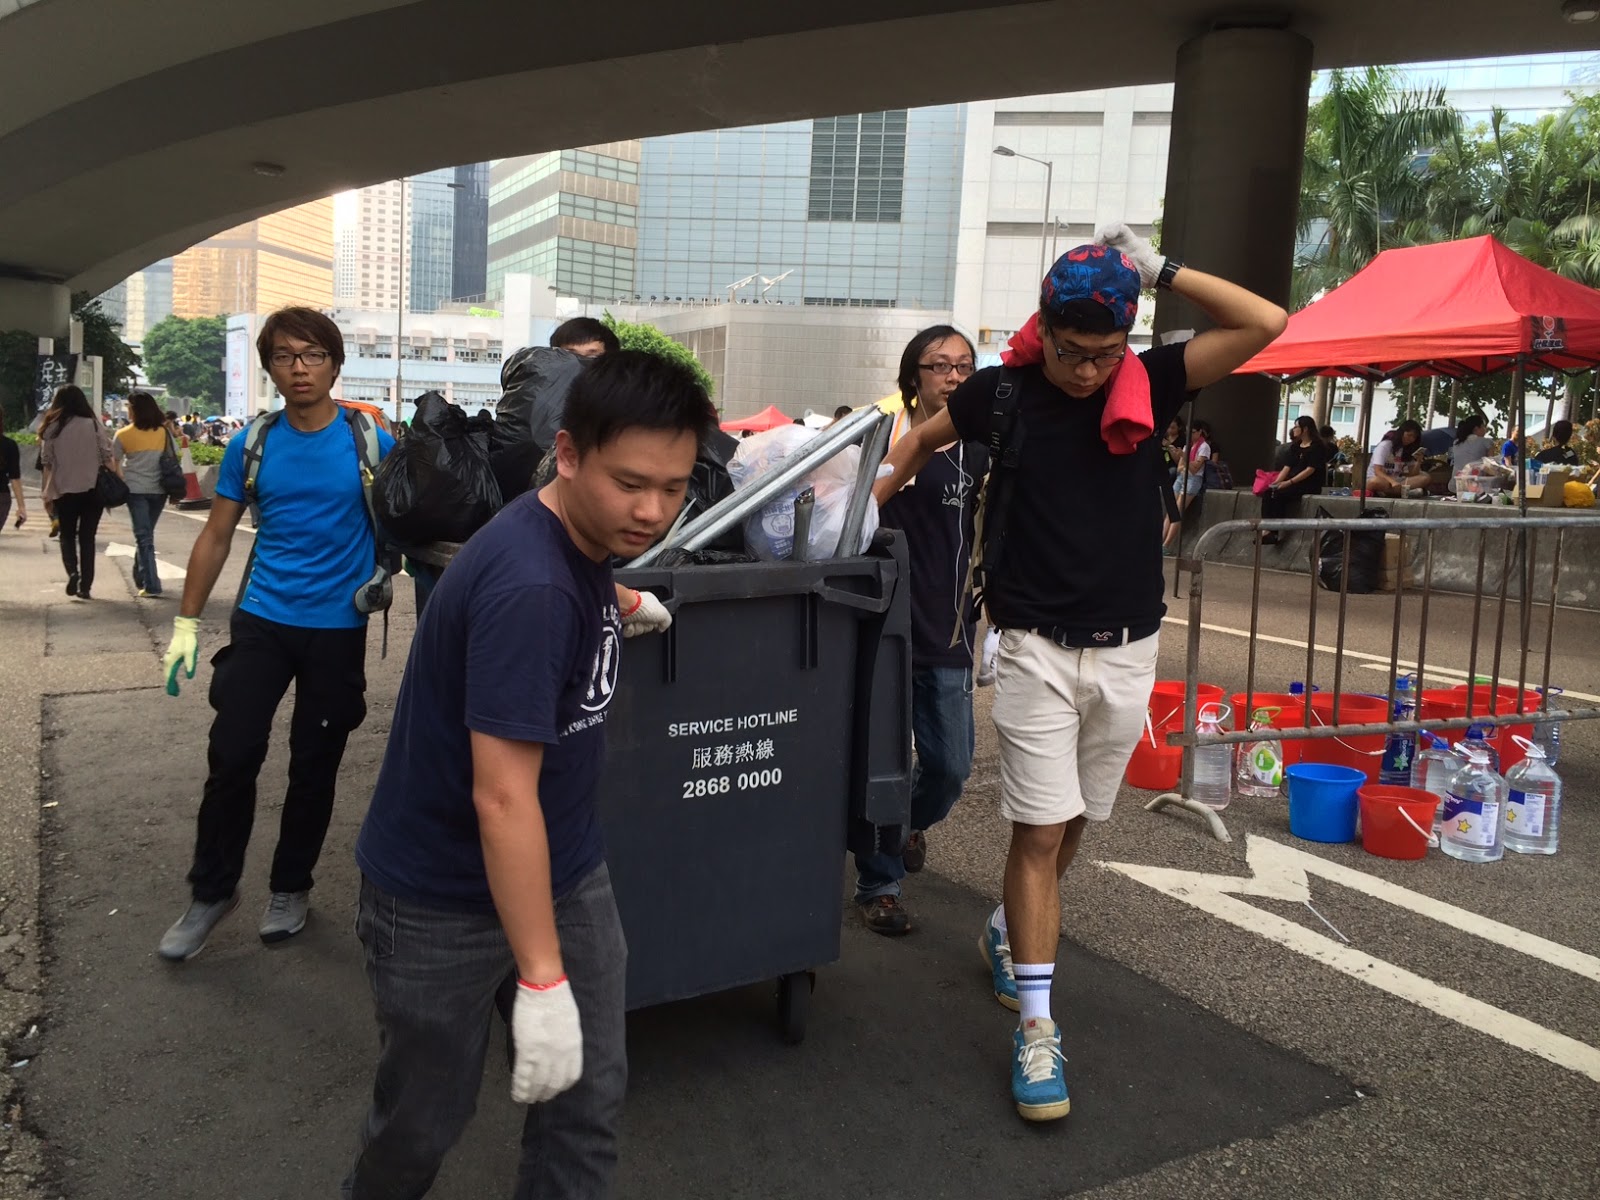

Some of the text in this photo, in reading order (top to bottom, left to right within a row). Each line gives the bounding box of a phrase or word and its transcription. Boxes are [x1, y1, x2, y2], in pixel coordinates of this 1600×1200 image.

[668, 708, 798, 737] SERVICE HOTLINE
[692, 738, 775, 769] 服務熱線
[682, 767, 783, 799] 2868 0000
